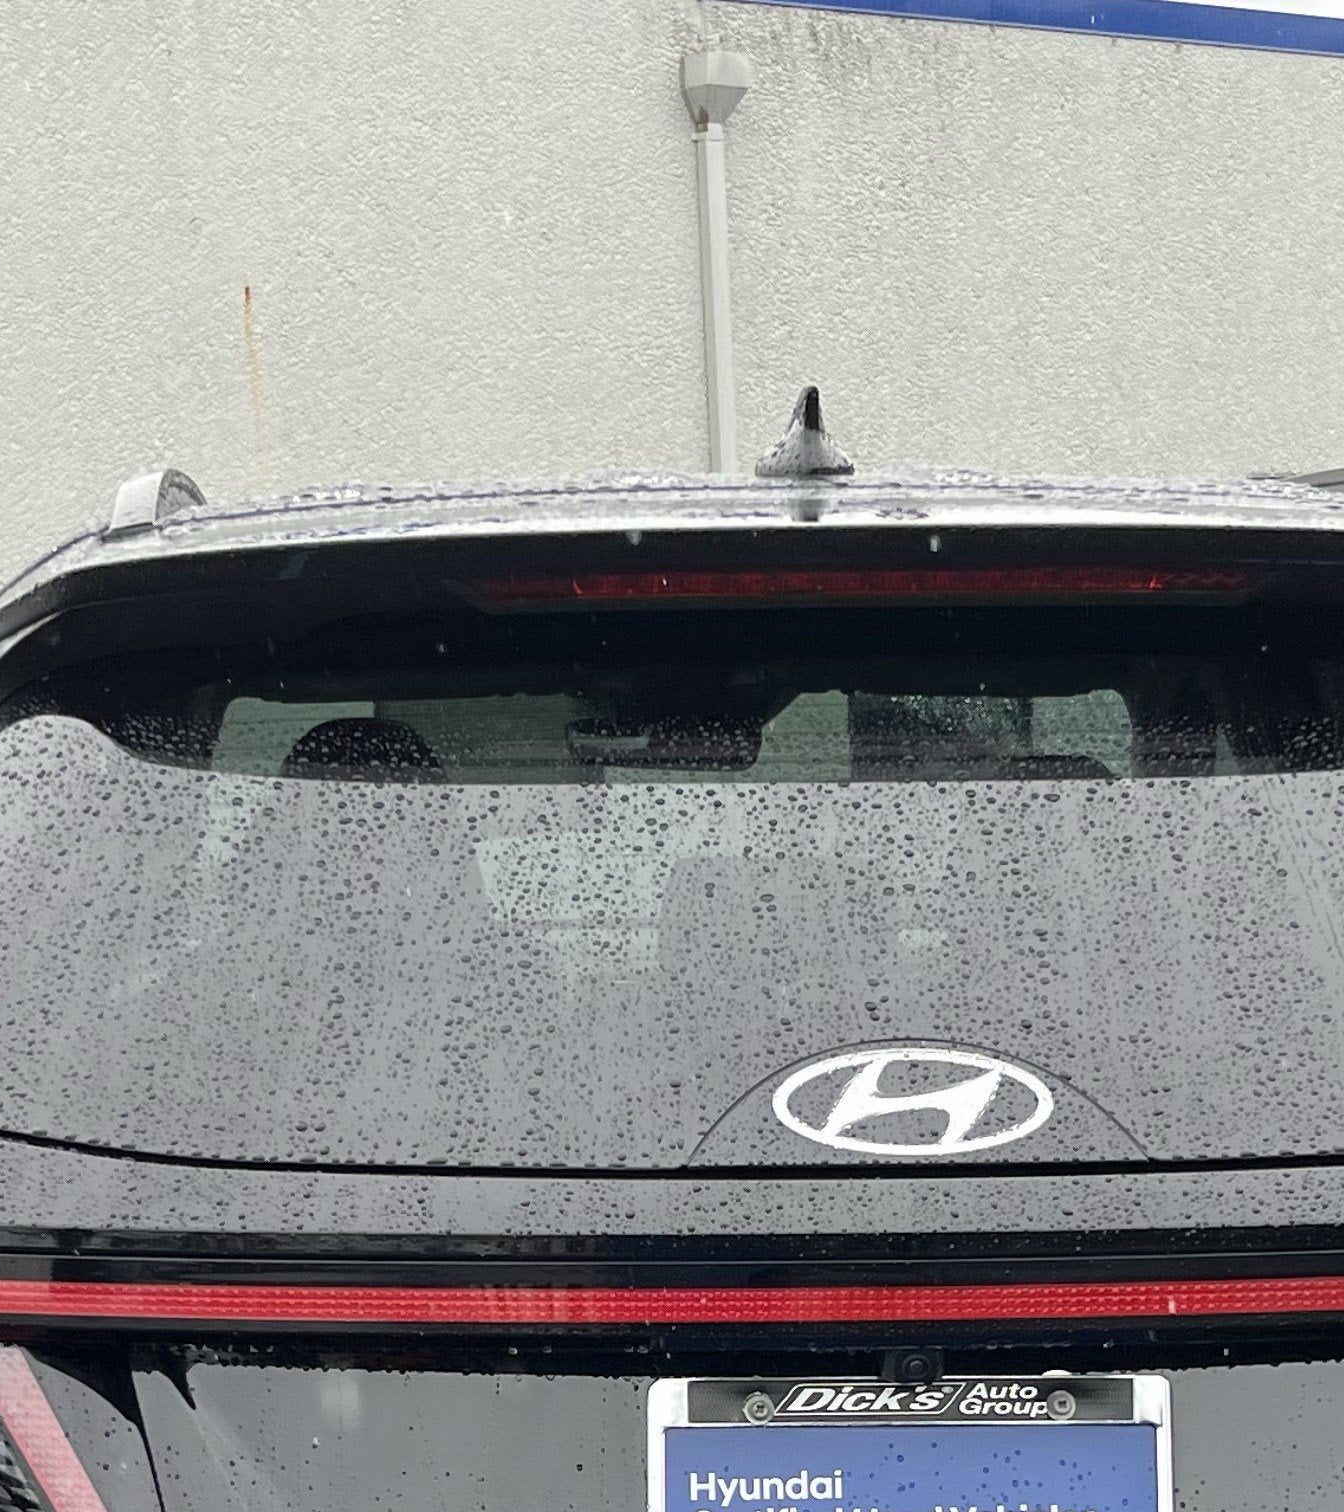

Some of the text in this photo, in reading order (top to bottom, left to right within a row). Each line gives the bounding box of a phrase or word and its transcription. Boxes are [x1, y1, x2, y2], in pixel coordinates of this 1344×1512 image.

[786, 1386, 946, 1411] Dick's
[966, 1382, 1038, 1400] Auto
[958, 1399, 1049, 1417] Group
[689, 1469, 843, 1508] Hyundai
